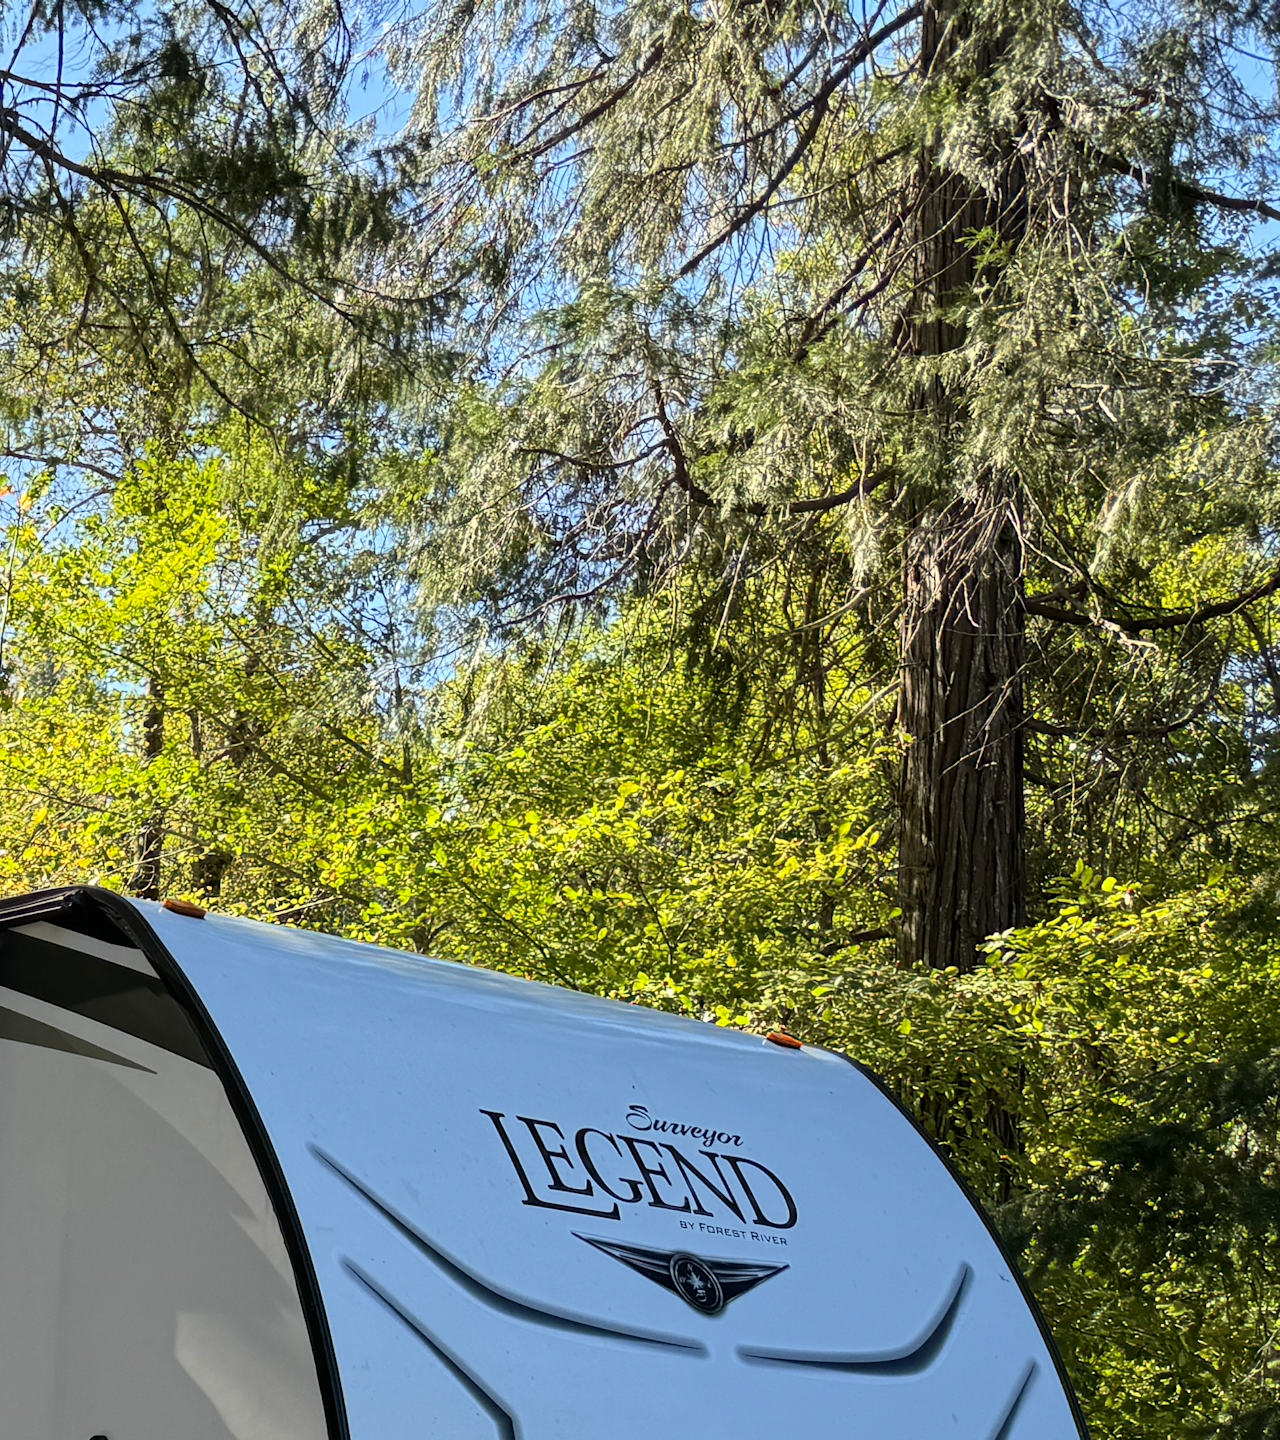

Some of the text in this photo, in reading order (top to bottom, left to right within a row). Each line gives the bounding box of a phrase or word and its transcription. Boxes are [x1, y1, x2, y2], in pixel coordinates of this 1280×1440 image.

[626, 1105, 743, 1147] Surveyor
[480, 1109, 797, 1229] LEGEND
[680, 1220, 788, 1246] BY FOREST RIVER
